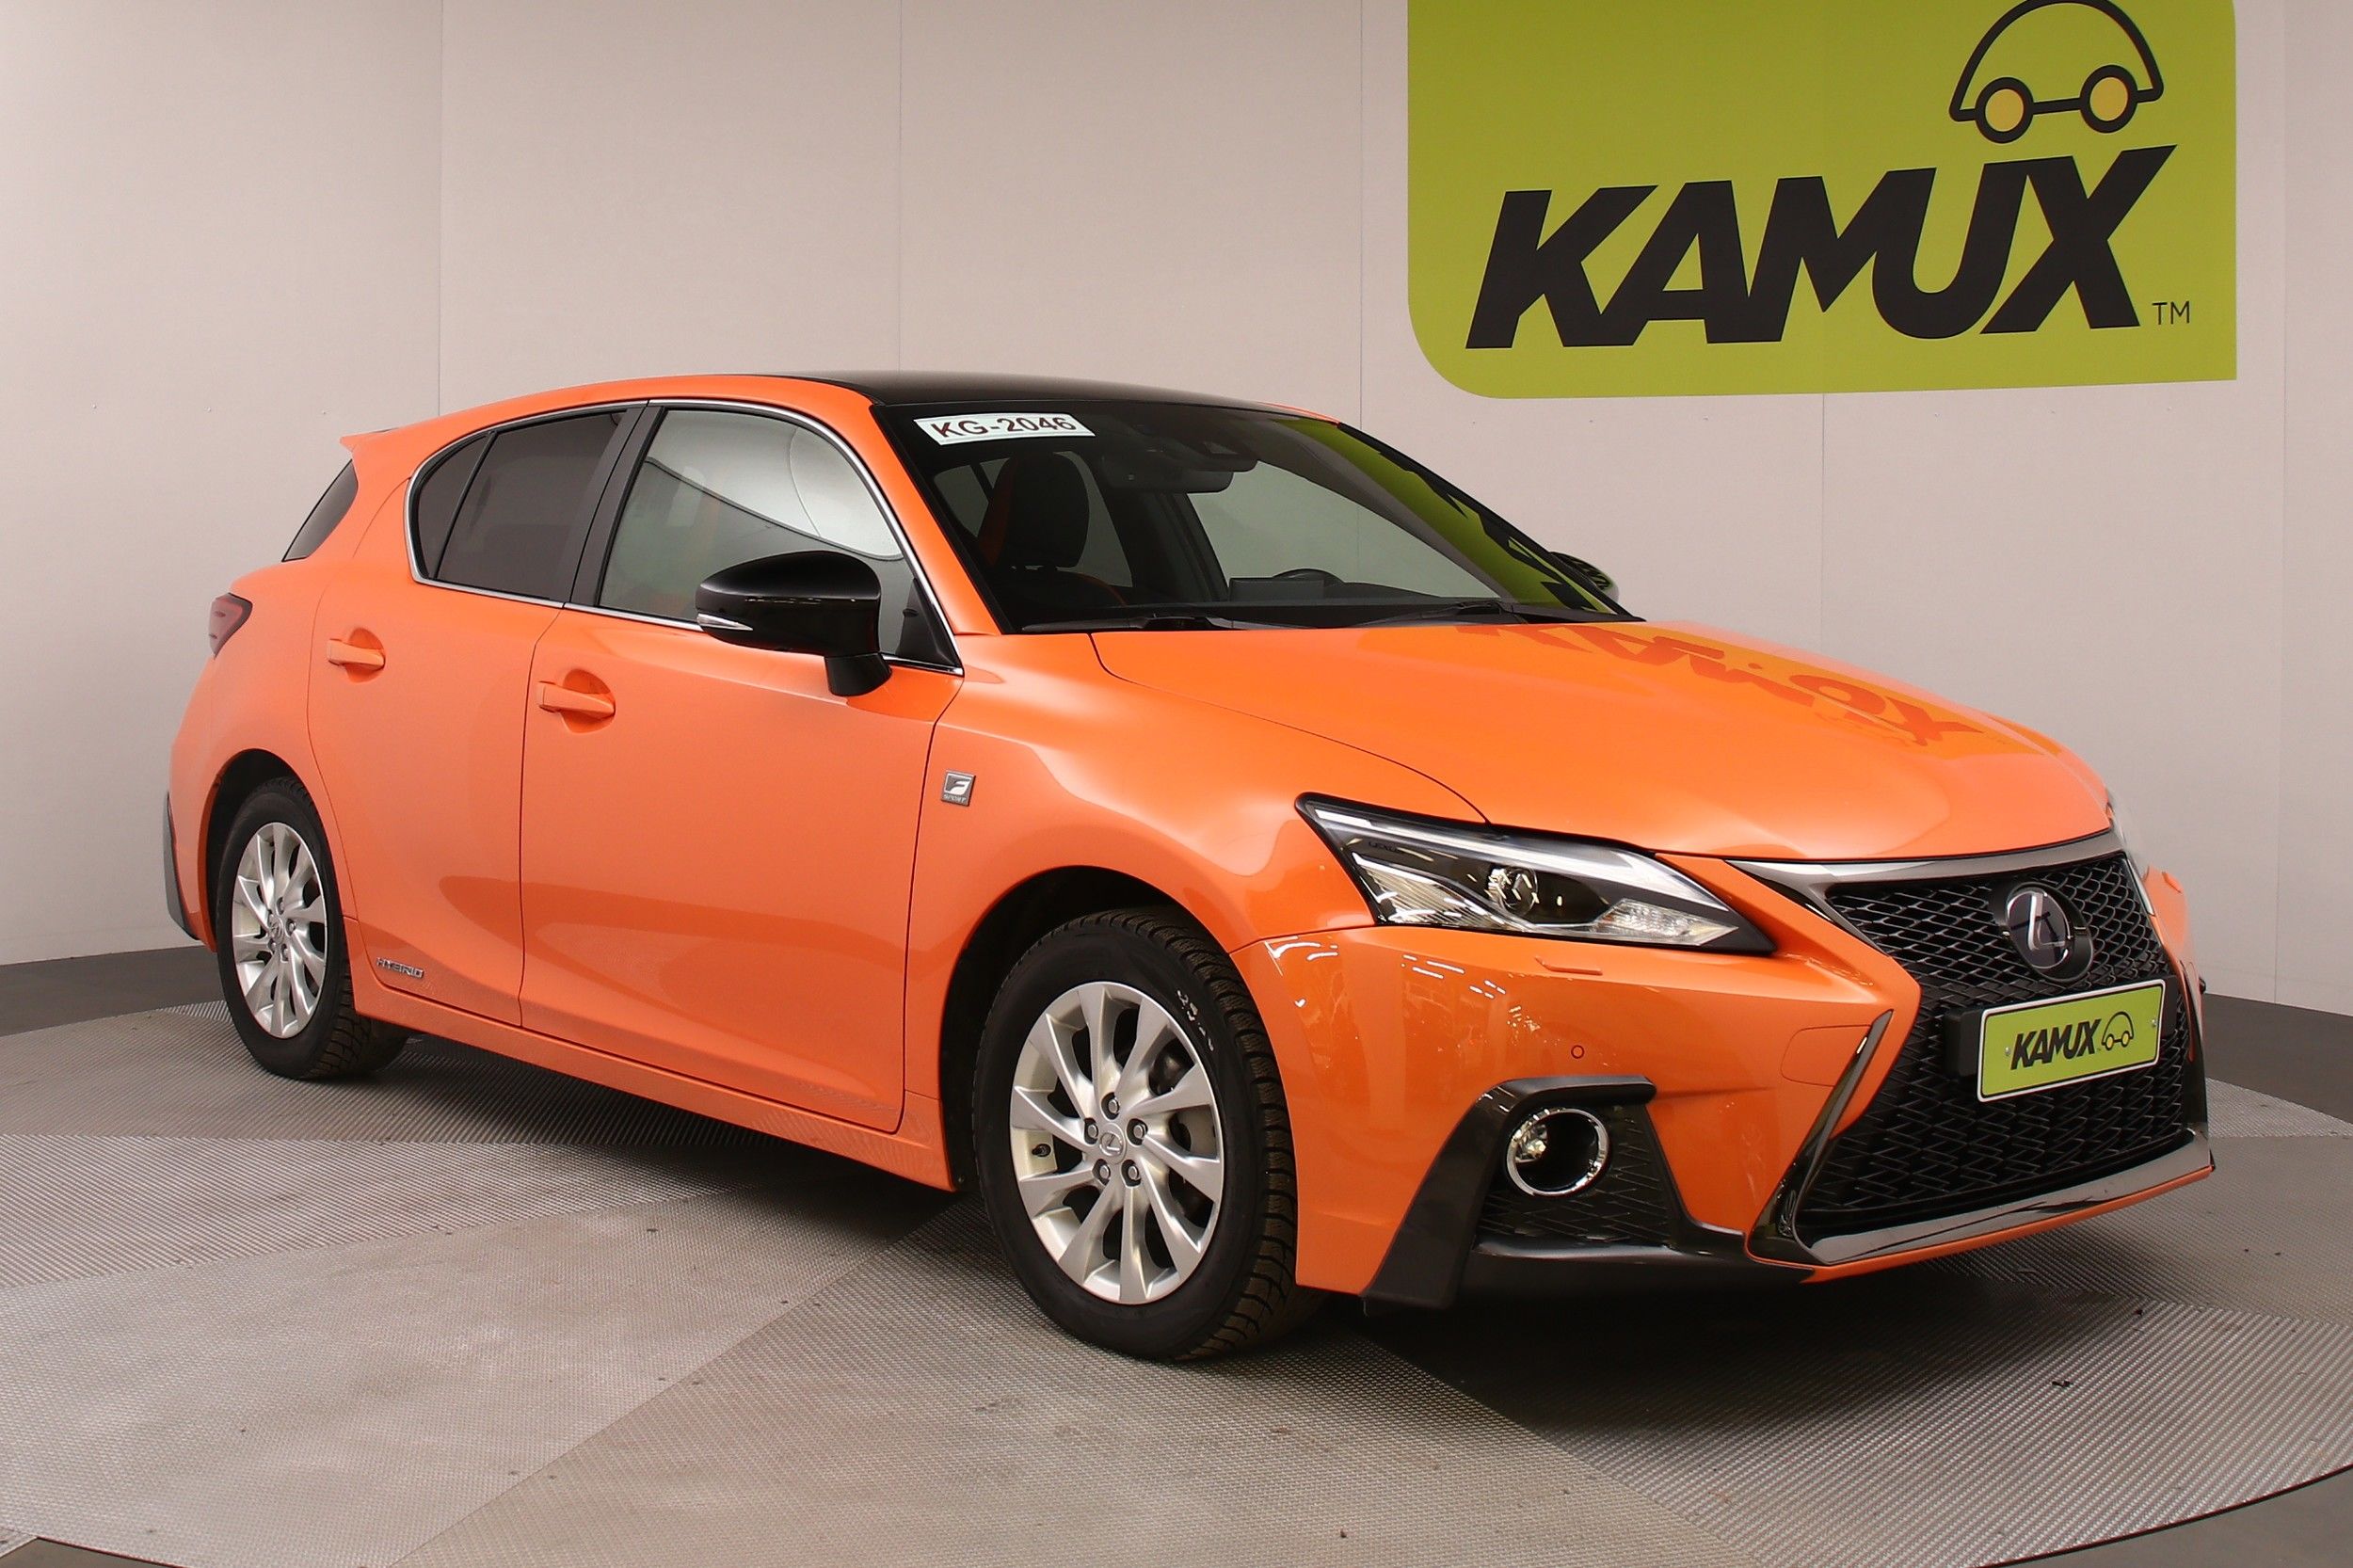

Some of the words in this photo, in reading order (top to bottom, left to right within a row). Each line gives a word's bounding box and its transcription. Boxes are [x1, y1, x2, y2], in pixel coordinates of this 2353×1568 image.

[1465, 145, 2177, 349] KAMUX
[2152, 300, 2190, 326] TM
[930, 416, 1077, 439] KG-2046
[2010, 1018, 2102, 1066] KAMUX
